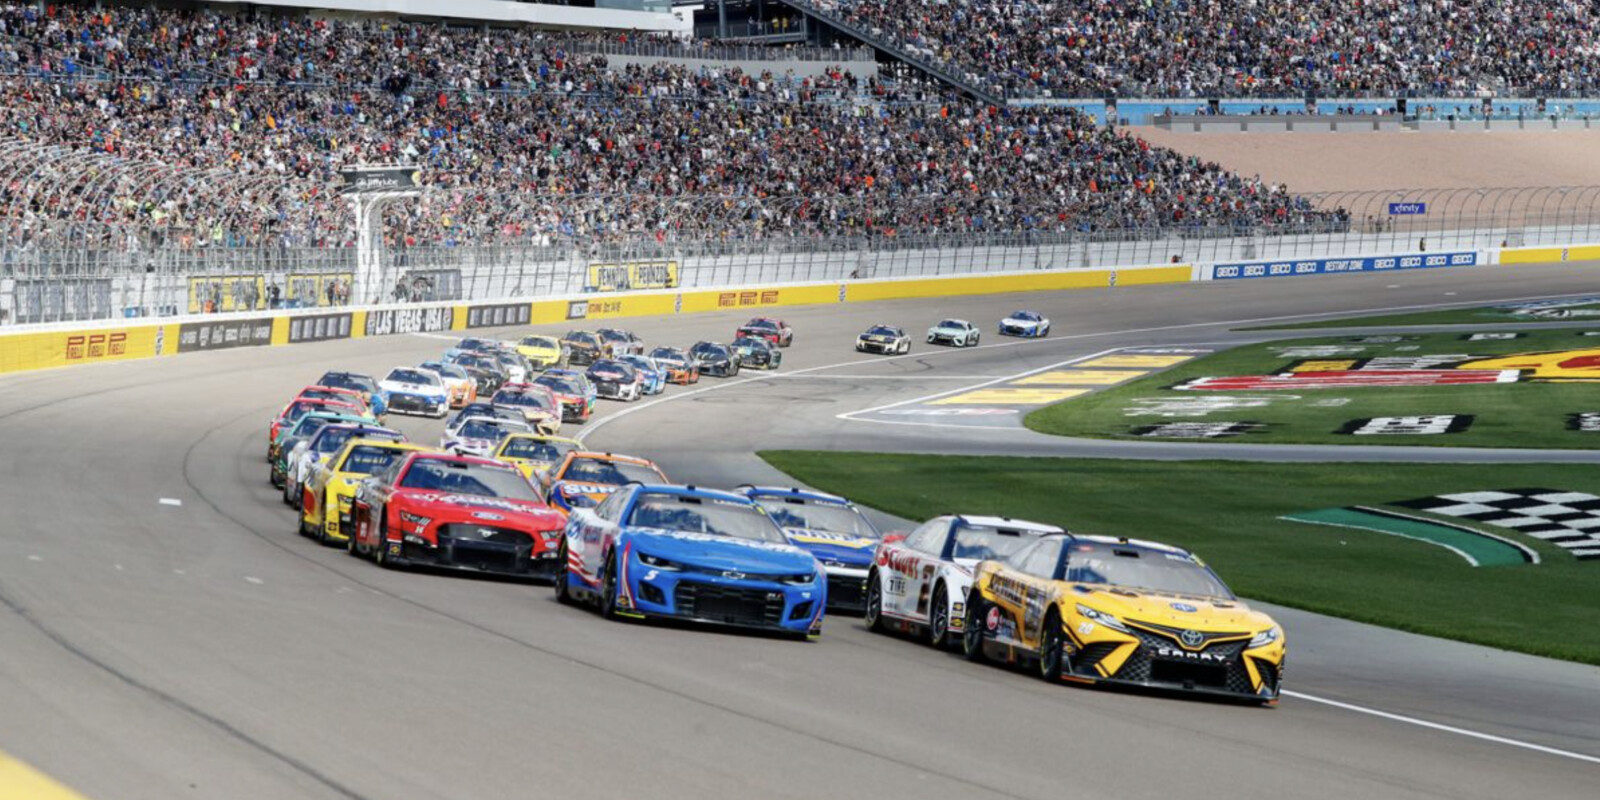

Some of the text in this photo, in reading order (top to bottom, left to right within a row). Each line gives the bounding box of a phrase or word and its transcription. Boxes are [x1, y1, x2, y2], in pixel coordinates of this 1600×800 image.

[1394, 204, 1420, 214] xfinity
[1216, 267, 1238, 277] GEICO
[1243, 265, 1265, 276] GEICO
[1270, 264, 1290, 275] GEICO
[1296, 262, 1317, 273] GEICO
[1374, 259, 1395, 268] GEICO
[1400, 257, 1422, 267] GEICO
[1426, 256, 1447, 265] GEICO
[1452, 254, 1473, 264] GEICO
[376, 311, 392, 334] LAS
[395, 309, 422, 332] VEGAS
[425, 308, 442, 331] USA
[644, 571, 659, 581] 5
[889, 578, 906, 594] TIRE
[1078, 621, 1095, 635] 20
[1158, 648, 1226, 662] CAMRY
